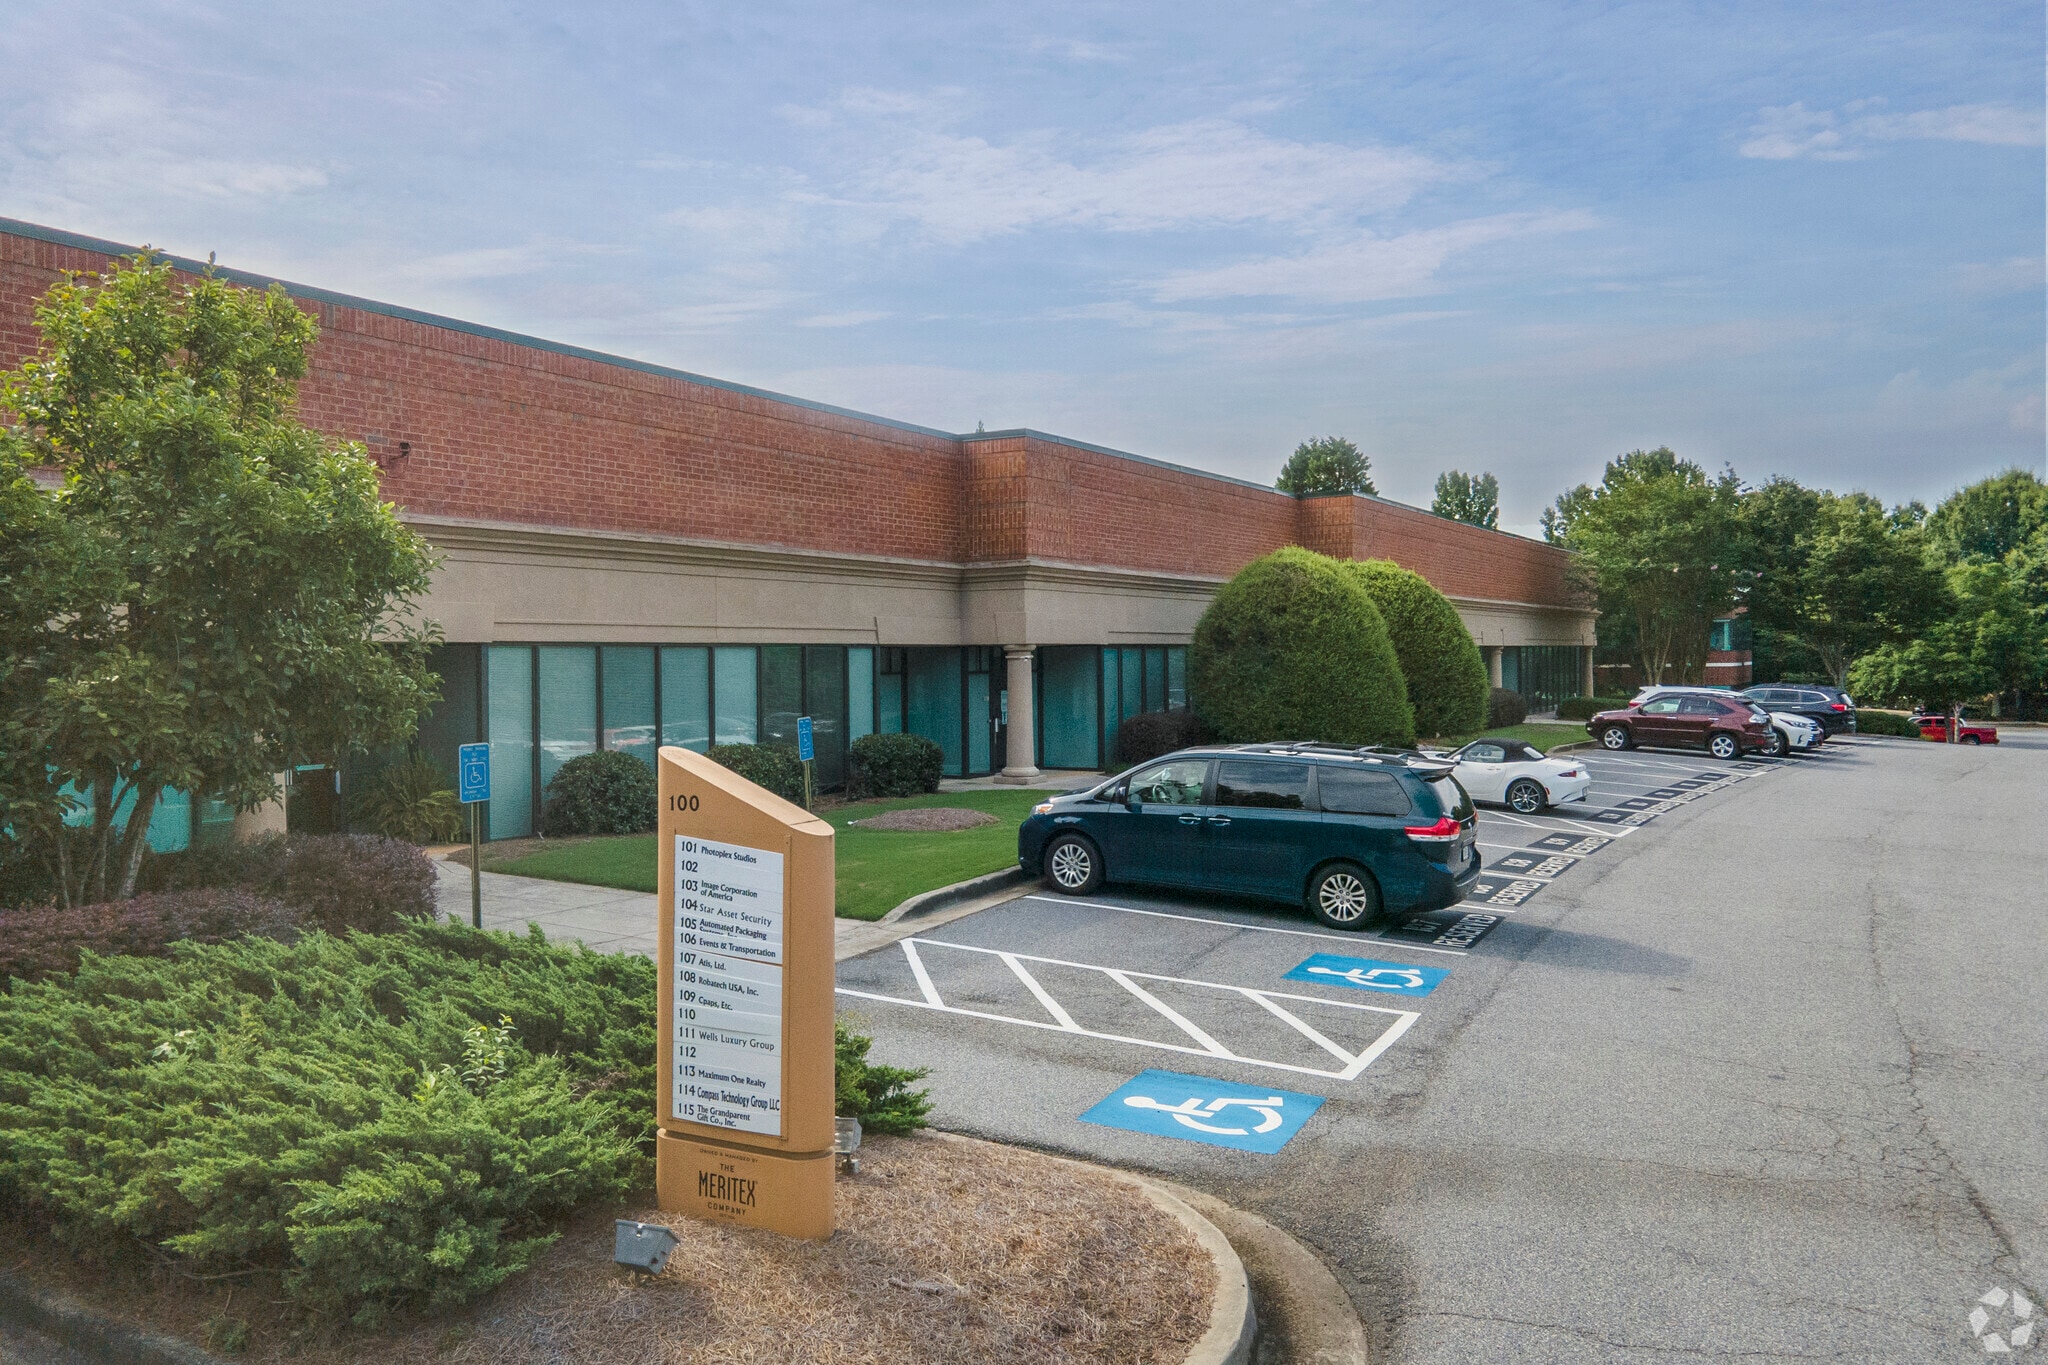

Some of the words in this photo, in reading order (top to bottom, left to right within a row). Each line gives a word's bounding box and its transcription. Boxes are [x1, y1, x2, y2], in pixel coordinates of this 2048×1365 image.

[669, 794, 700, 812] 100
[681, 841, 697, 853] 101
[701, 845, 732, 859] Photoplex
[733, 852, 757, 864] Studios
[681, 860, 698, 873] 102
[681, 879, 698, 892] 103
[701, 880, 719, 891] Image
[720, 884, 758, 899] Corporation
[707, 890, 733, 901] America
[1486, 880, 1541, 906] RESERVED
[681, 898, 698, 911] 104
[699, 903, 715, 914] Star
[717, 908, 738, 920] Asset
[740, 912, 772, 928] Security
[680, 917, 697, 930] 105
[699, 918, 734, 932] Automated
[735, 926, 767, 941] Packaging
[1433, 913, 1497, 948] RESERVED
[680, 932, 697, 945] 106
[699, 937, 719, 949] Events
[720, 942, 727, 950] &
[728, 942, 776, 958] Transportation
[680, 952, 697, 965] 107
[714, 961, 727, 971] Ltd.
[680, 970, 696, 983] 108
[698, 976, 727, 990] Robatech
[728, 983, 745, 995] USA,
[746, 986, 760, 996] Inc.
[679, 989, 696, 1002] 109
[698, 996, 720, 1009] Cpaps,
[721, 1001, 733, 1011] Etc.
[679, 1007, 696, 1020] 110
[679, 1026, 695, 1039] 111
[699, 1030, 719, 1042] Wells
[720, 1034, 747, 1048] Luxury
[749, 1038, 775, 1052] Group
[679, 1045, 697, 1058] 112
[679, 1064, 696, 1077] 113
[698, 1069, 730, 1082] Maximum
[730, 1074, 745, 1084] One
[746, 1077, 767, 1089] Realty
[679, 1083, 696, 1096] 114
[697, 1086, 719, 1102] Compass
[720, 1090, 750, 1108] Technology
[750, 1095, 768, 1111] Group
[769, 1098, 780, 1111] LLC
[678, 1102, 695, 1116] 115
[697, 1104, 709, 1114] The
[710, 1107, 751, 1121] Grandparent
[697, 1113, 709, 1122] Gift
[724, 1118, 737, 1127] Inc.
[720, 1163, 735, 1173] THE
[698, 1170, 756, 1208] MERITEX
[707, 1201, 746, 1216] COMPANY
